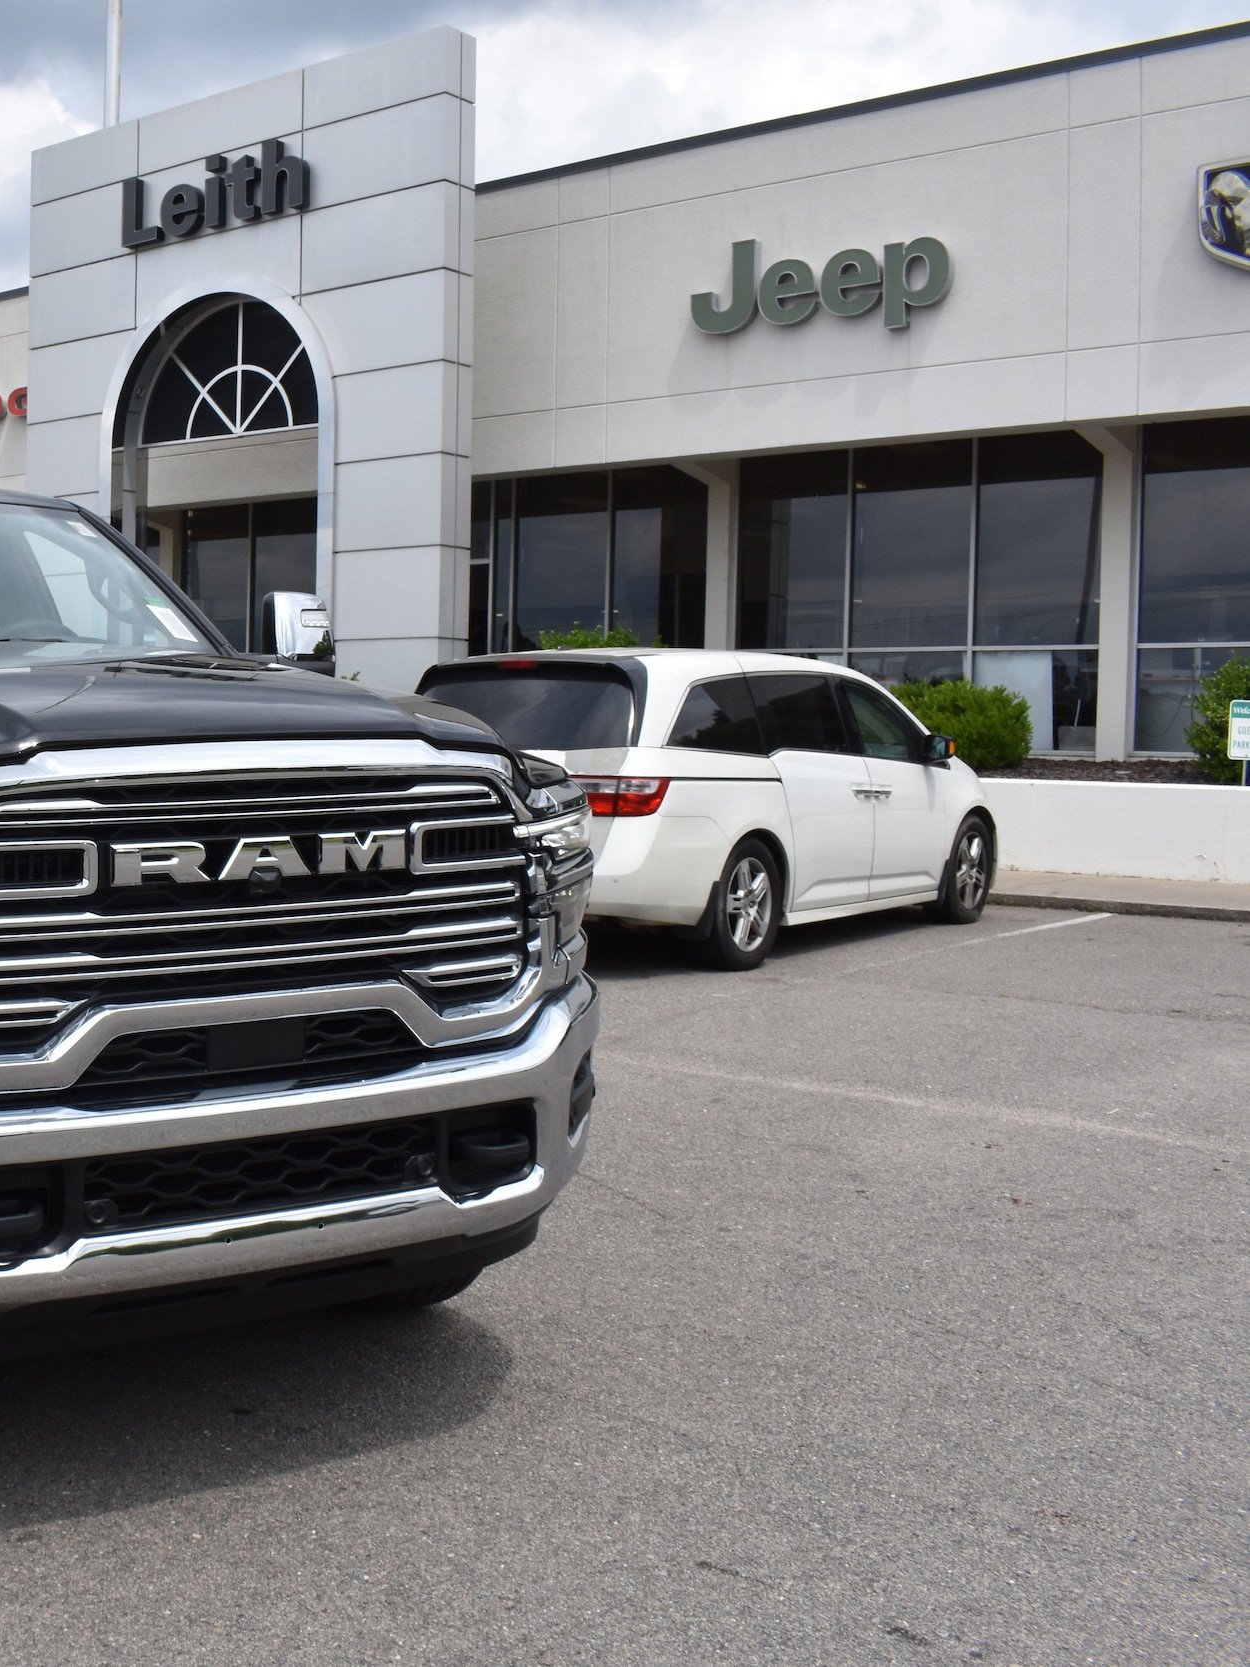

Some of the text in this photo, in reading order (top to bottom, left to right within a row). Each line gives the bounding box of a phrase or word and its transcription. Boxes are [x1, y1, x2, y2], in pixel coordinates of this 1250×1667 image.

[121, 138, 310, 248] Leith
[690, 236, 953, 335] Jeep
[110, 828, 406, 887] RAM
